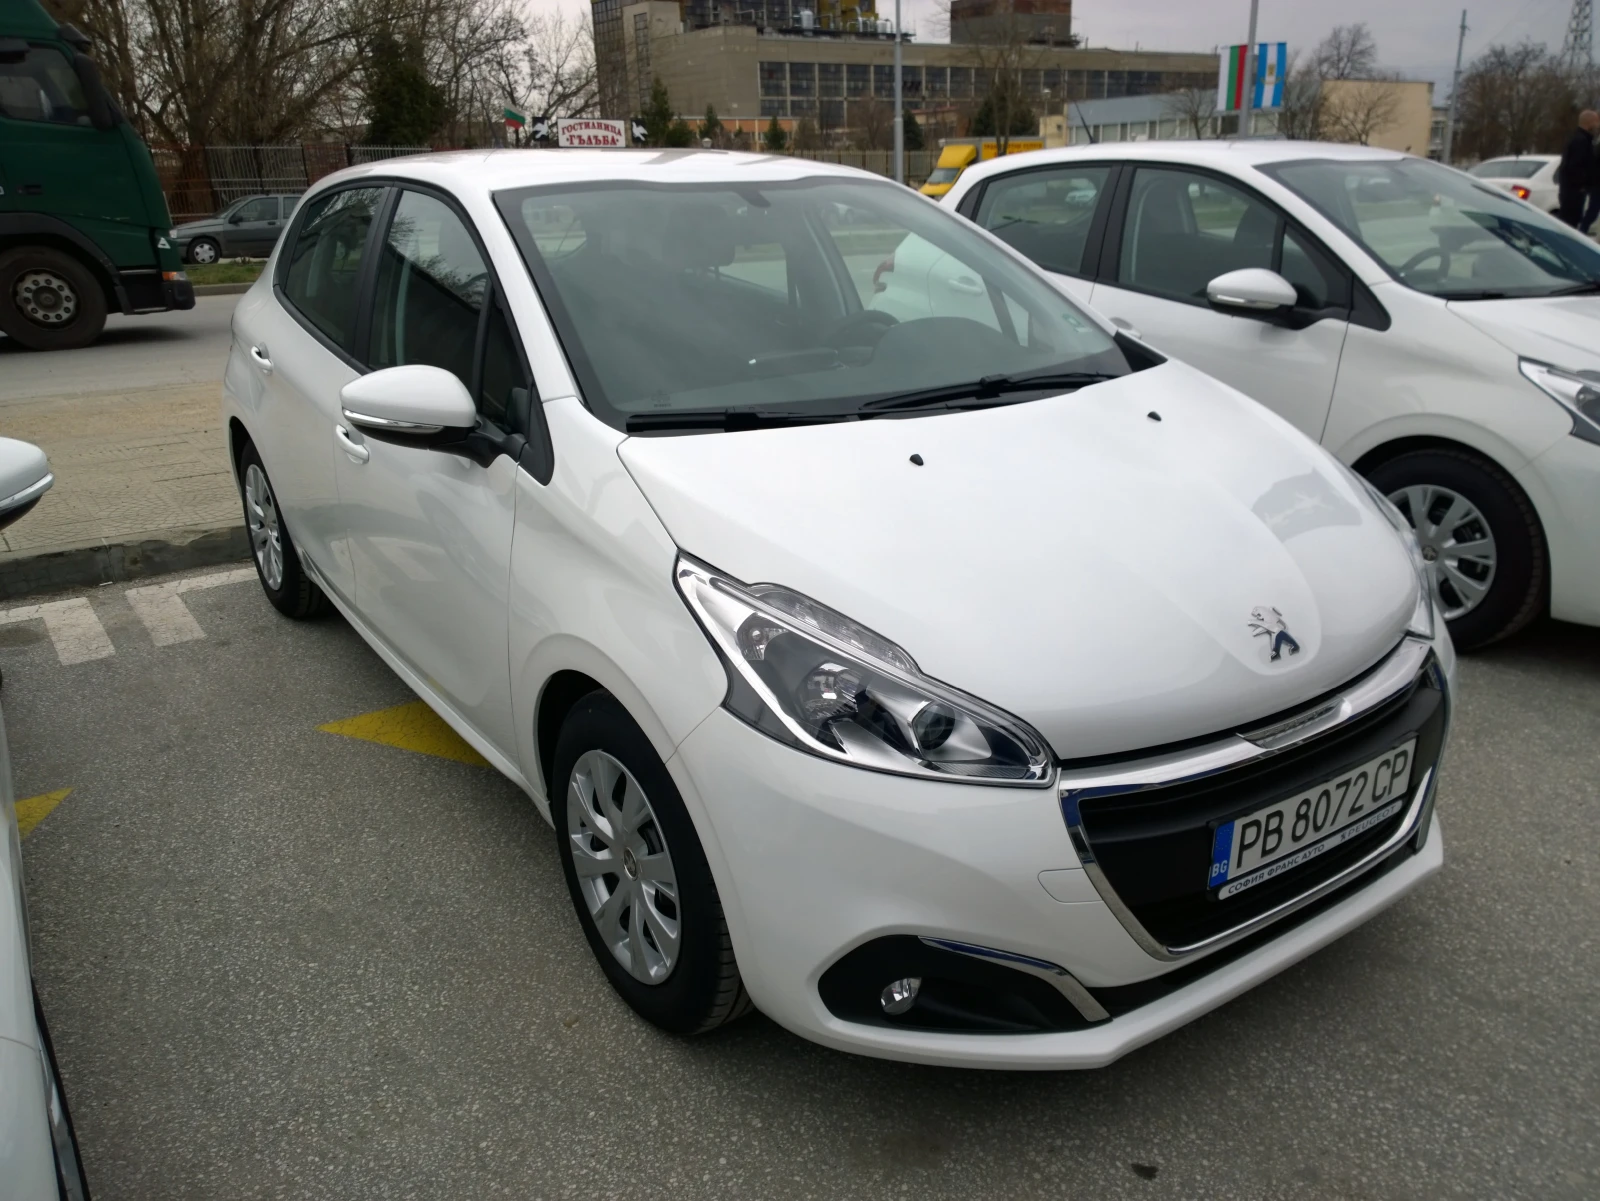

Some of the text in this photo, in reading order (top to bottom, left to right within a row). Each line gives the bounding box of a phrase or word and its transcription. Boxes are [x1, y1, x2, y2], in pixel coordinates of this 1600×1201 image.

[562, 121, 622, 136] ГОСТИЛНИЦА
[1236, 750, 1409, 869] PB 8072 CP
[1345, 805, 1397, 838] PEUGEOT
[1211, 861, 1227, 877] BG
[1228, 844, 1325, 894] СОФИЯ ФРАНС АУТО
